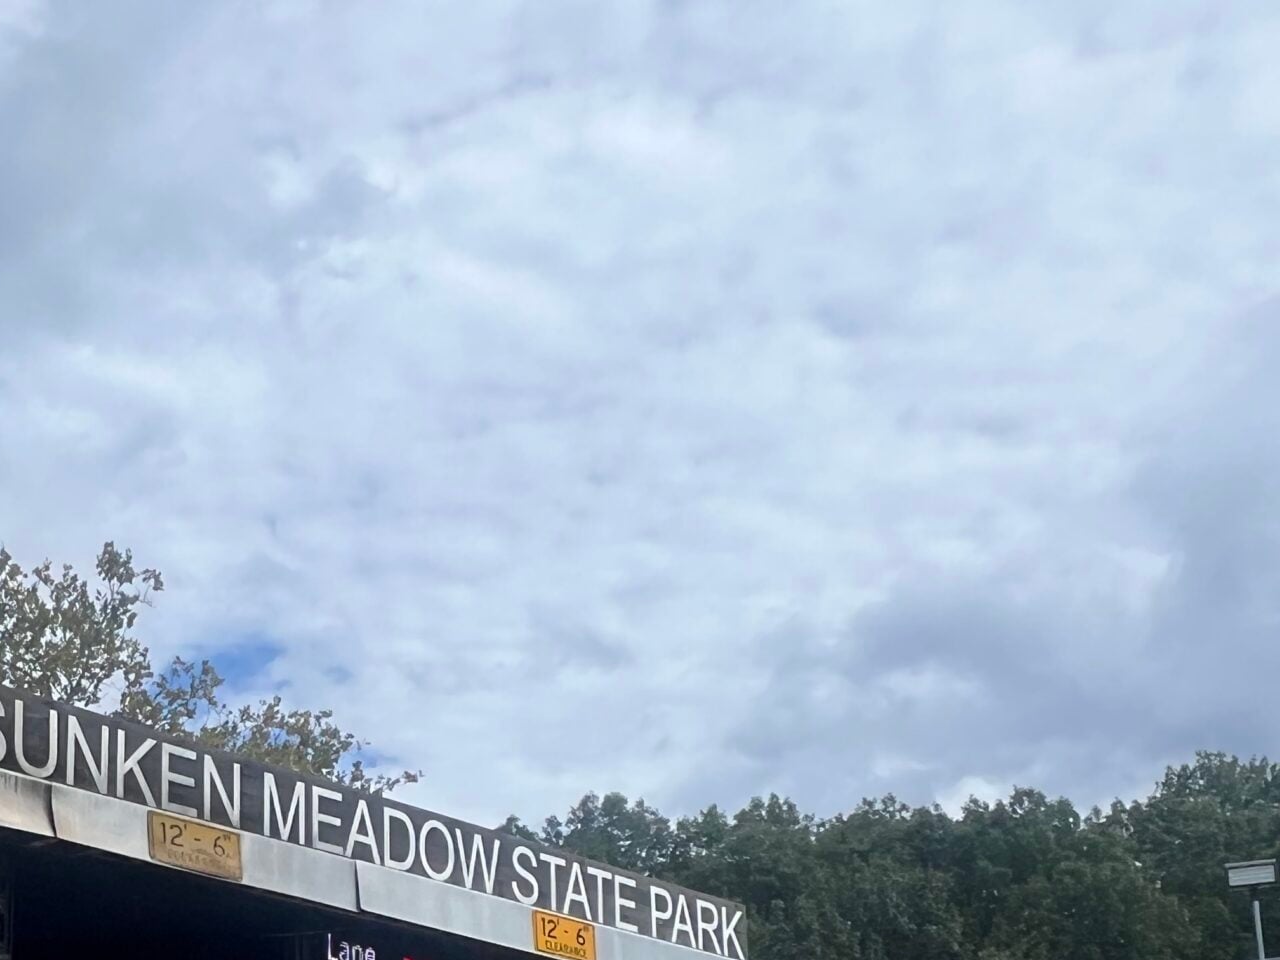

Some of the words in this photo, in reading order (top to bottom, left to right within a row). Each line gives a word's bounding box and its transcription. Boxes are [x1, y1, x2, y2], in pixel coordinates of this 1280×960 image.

[264, 772, 501, 895] MEADOW
[511, 846, 639, 933] STATE
[650, 885, 746, 960] PARK
